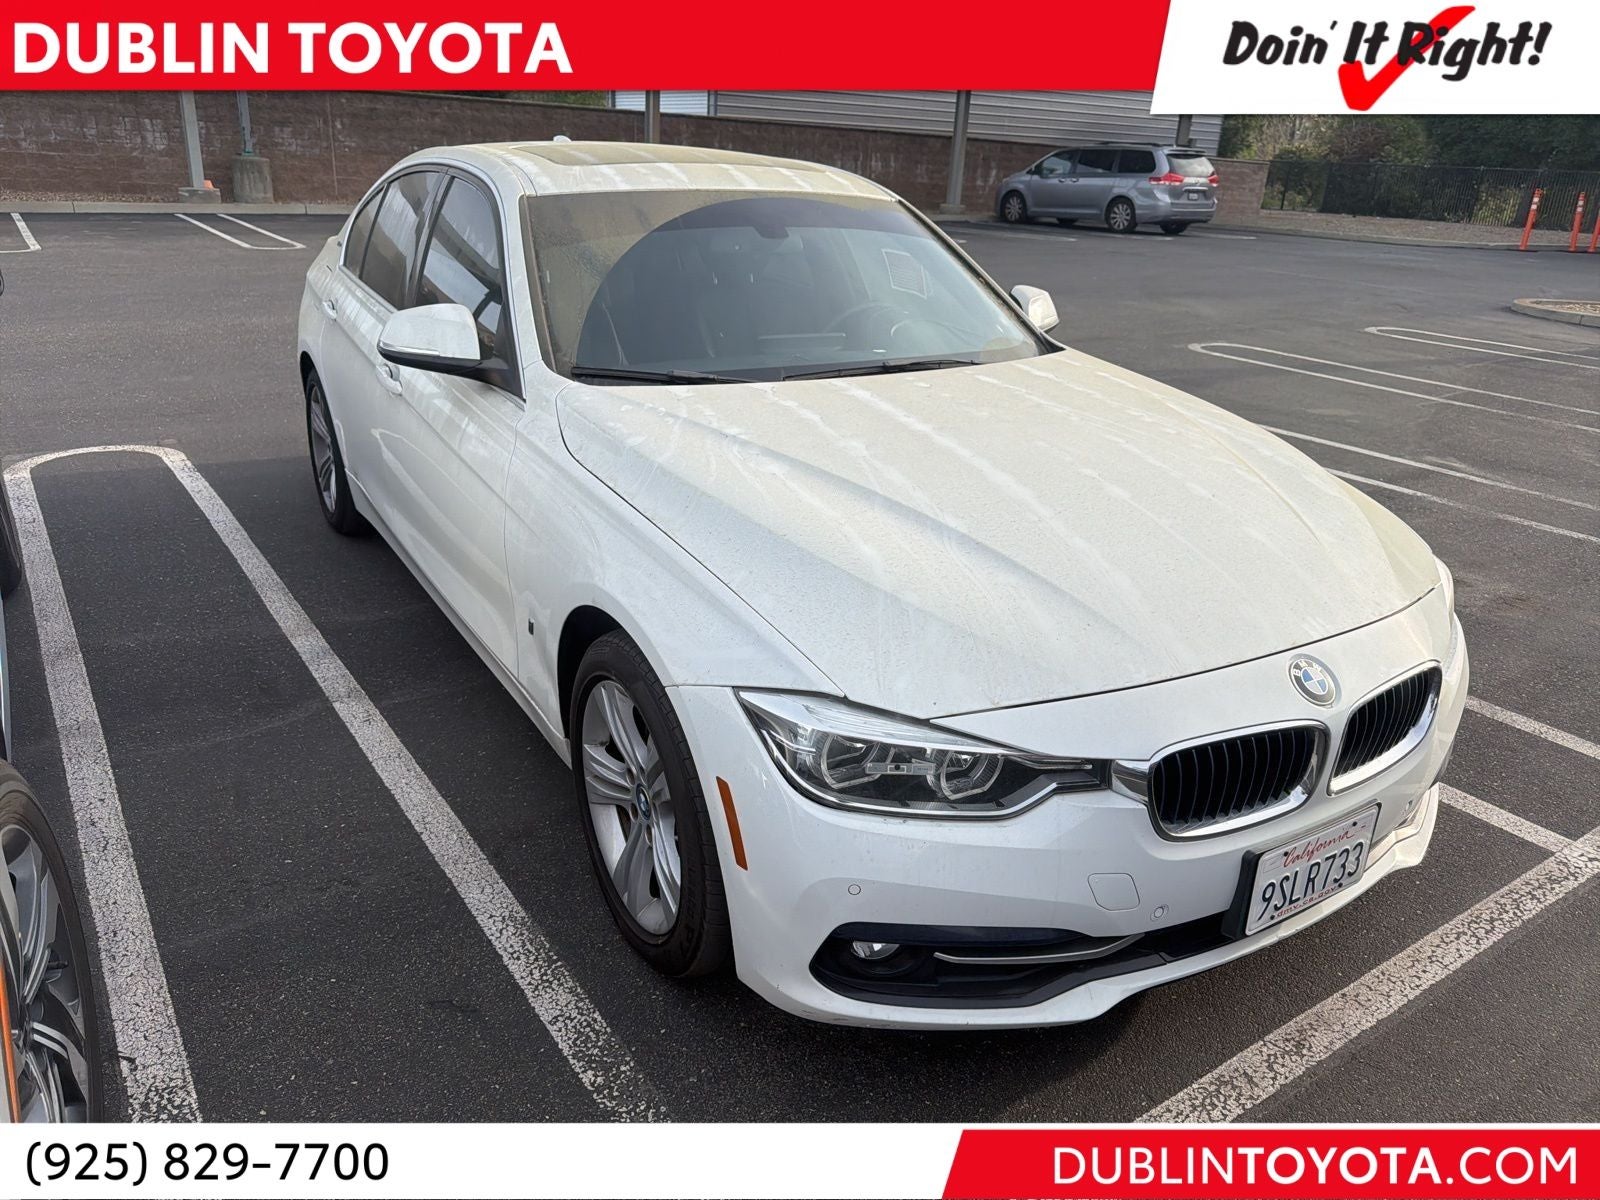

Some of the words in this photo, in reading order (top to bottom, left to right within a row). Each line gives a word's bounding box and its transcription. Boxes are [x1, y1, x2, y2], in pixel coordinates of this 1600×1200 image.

[1283, 829, 1355, 868] California
[1257, 841, 1364, 921] 9SLR733
[1276, 886, 1337, 918] dmv.ca.gov
